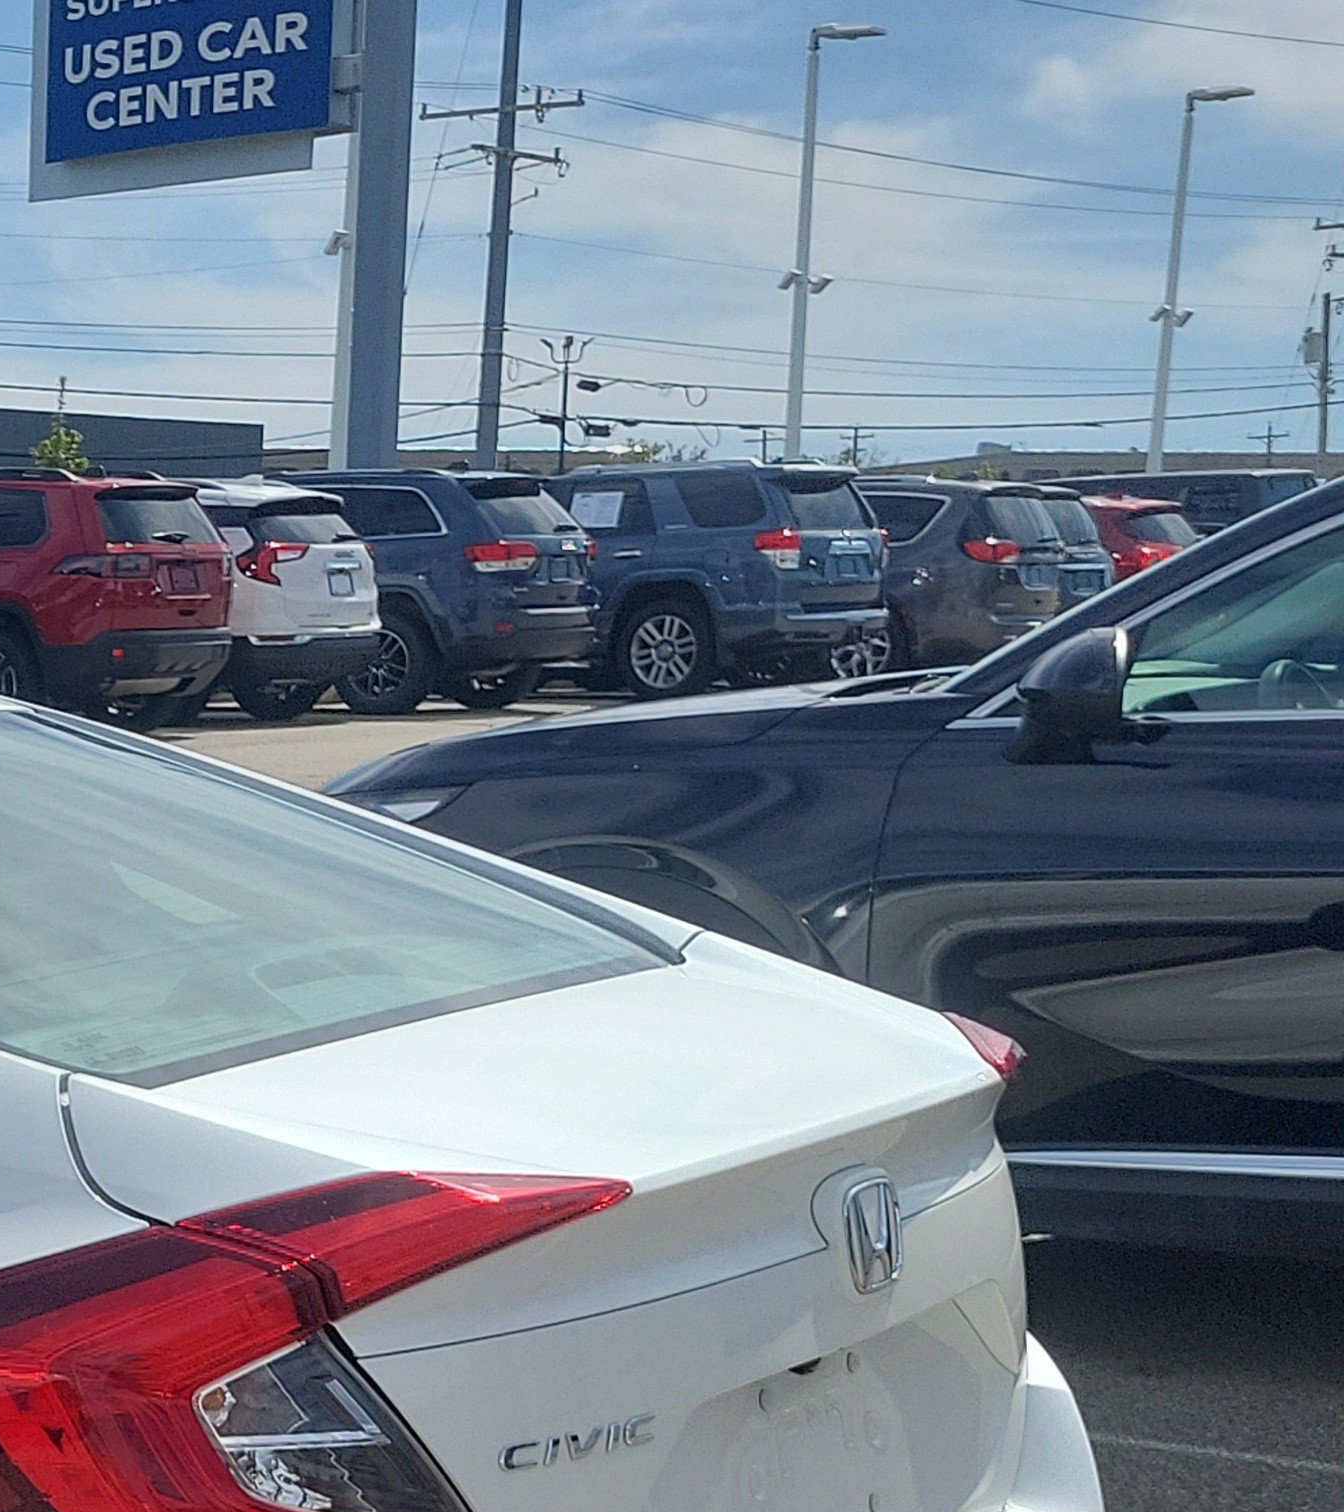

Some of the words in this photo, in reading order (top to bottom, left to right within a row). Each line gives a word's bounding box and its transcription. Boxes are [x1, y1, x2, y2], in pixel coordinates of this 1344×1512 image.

[63, 30, 183, 84] USED
[197, 12, 309, 62] CAR
[86, 69, 276, 130] CENTER
[497, 1413, 657, 1472] CIVIC
